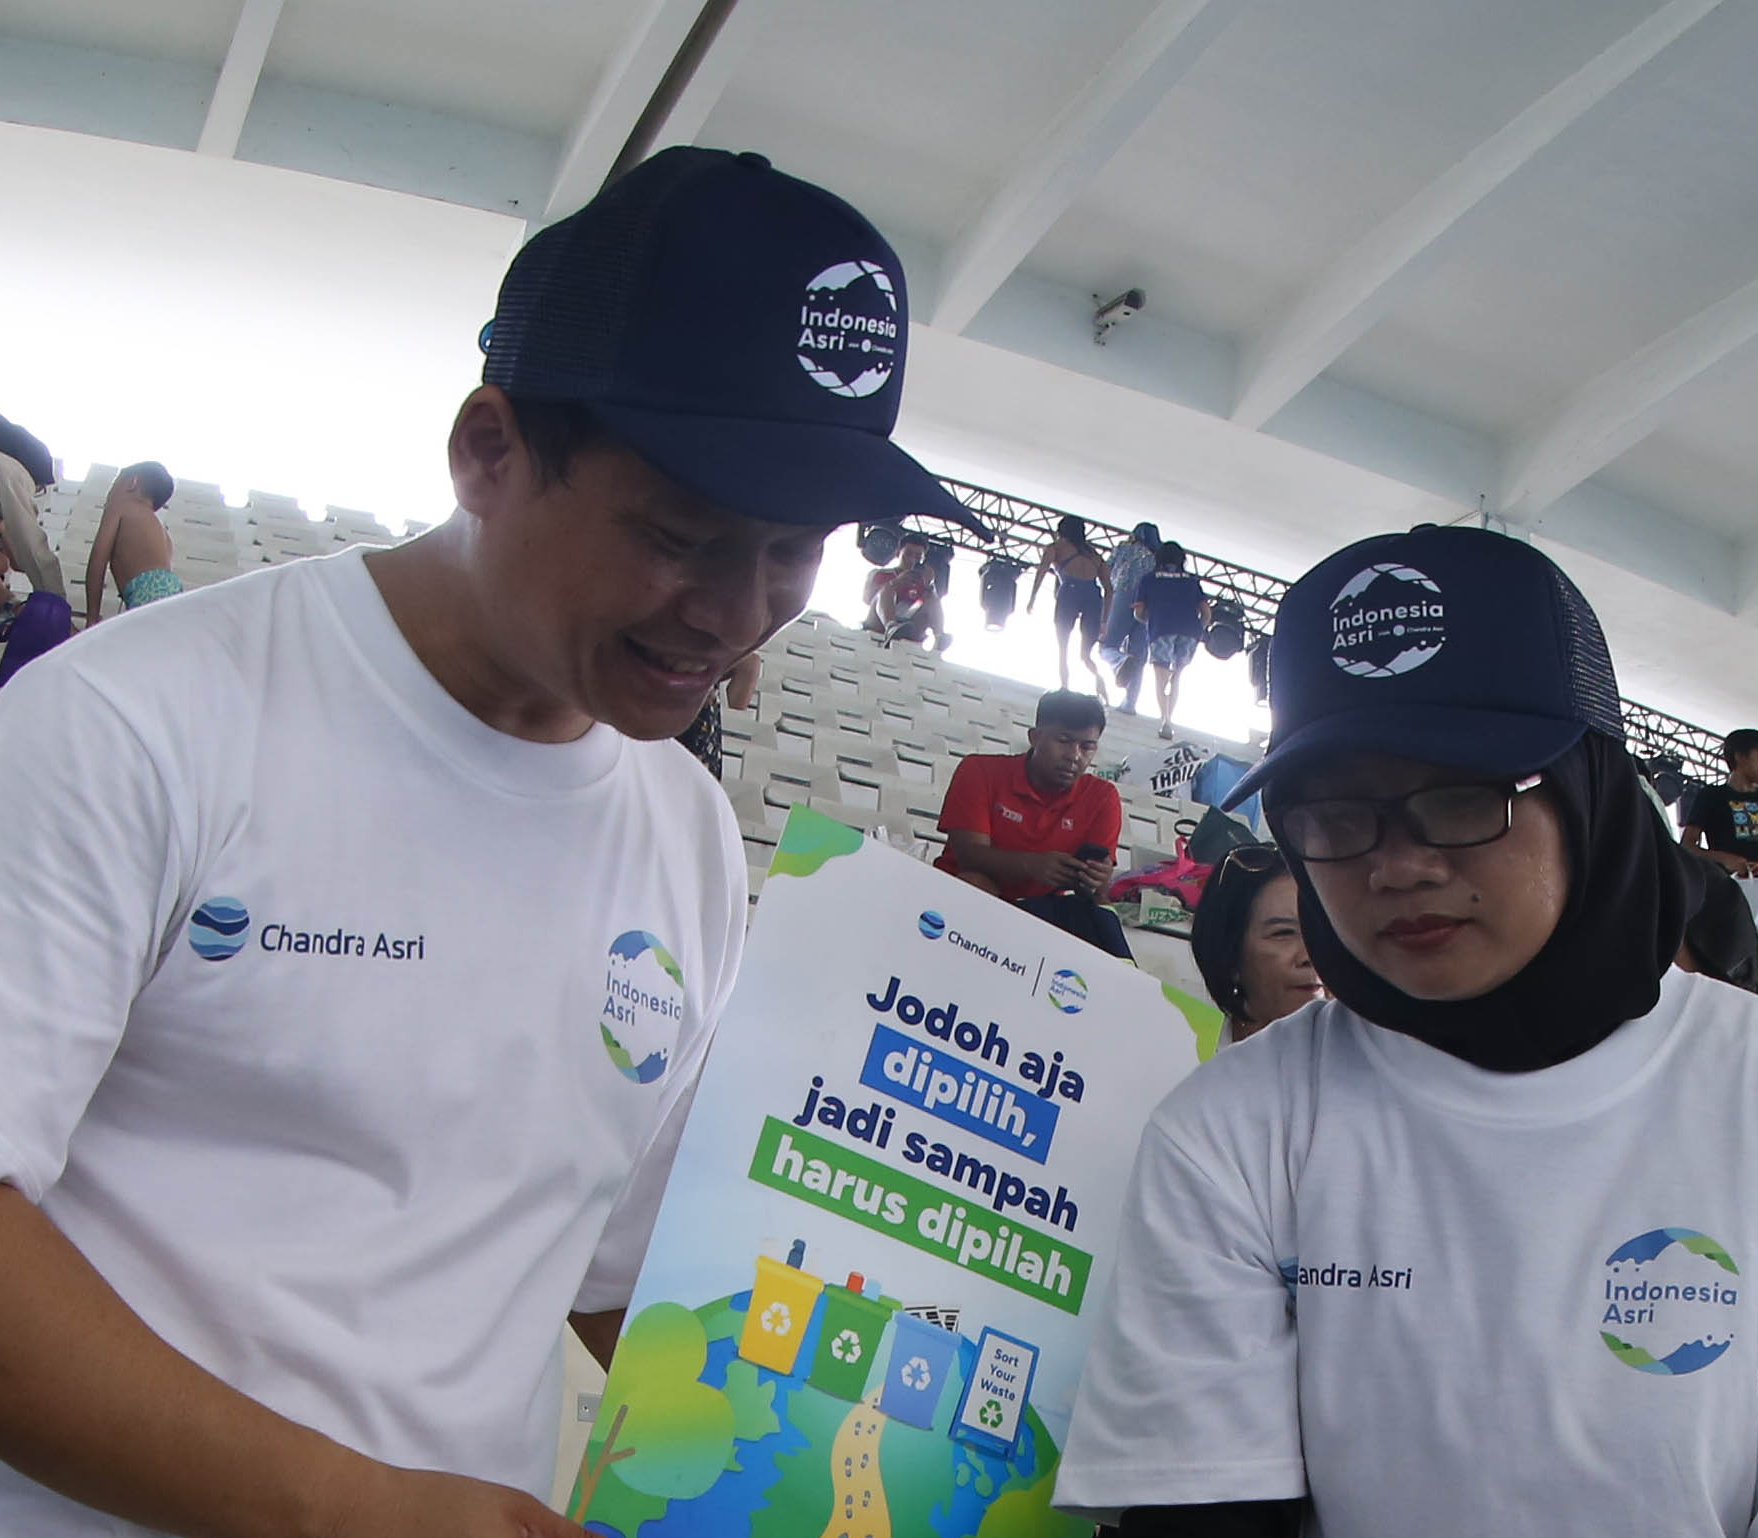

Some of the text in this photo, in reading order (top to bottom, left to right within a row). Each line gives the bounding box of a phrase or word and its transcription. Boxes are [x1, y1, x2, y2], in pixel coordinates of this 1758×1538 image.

[801, 305, 897, 339] Indonesia
[797, 327, 846, 351] Asri
[1332, 600, 1445, 633] Indonesia
[1332, 624, 1373, 651] Asri
[1149, 758, 1205, 792] THAIL
[259, 922, 425, 961] Chandra Asri
[947, 930, 1027, 977] Chandra Asri
[602, 995, 635, 1027] Asri
[865, 975, 1086, 1104] Jodoh aja
[881, 1046, 1037, 1148] dipilih,
[793, 1075, 1079, 1233] jadi sampah
[771, 1133, 1073, 1297] harus dipilah
[1298, 1264, 1413, 1290] andra Asri
[1604, 1278, 1738, 1307] Indonesia
[1601, 1302, 1655, 1325] Asri
[989, 1364, 1017, 1384] Your
[994, 1348, 1020, 1368] Sort
[980, 1377, 1016, 1402] Waste
